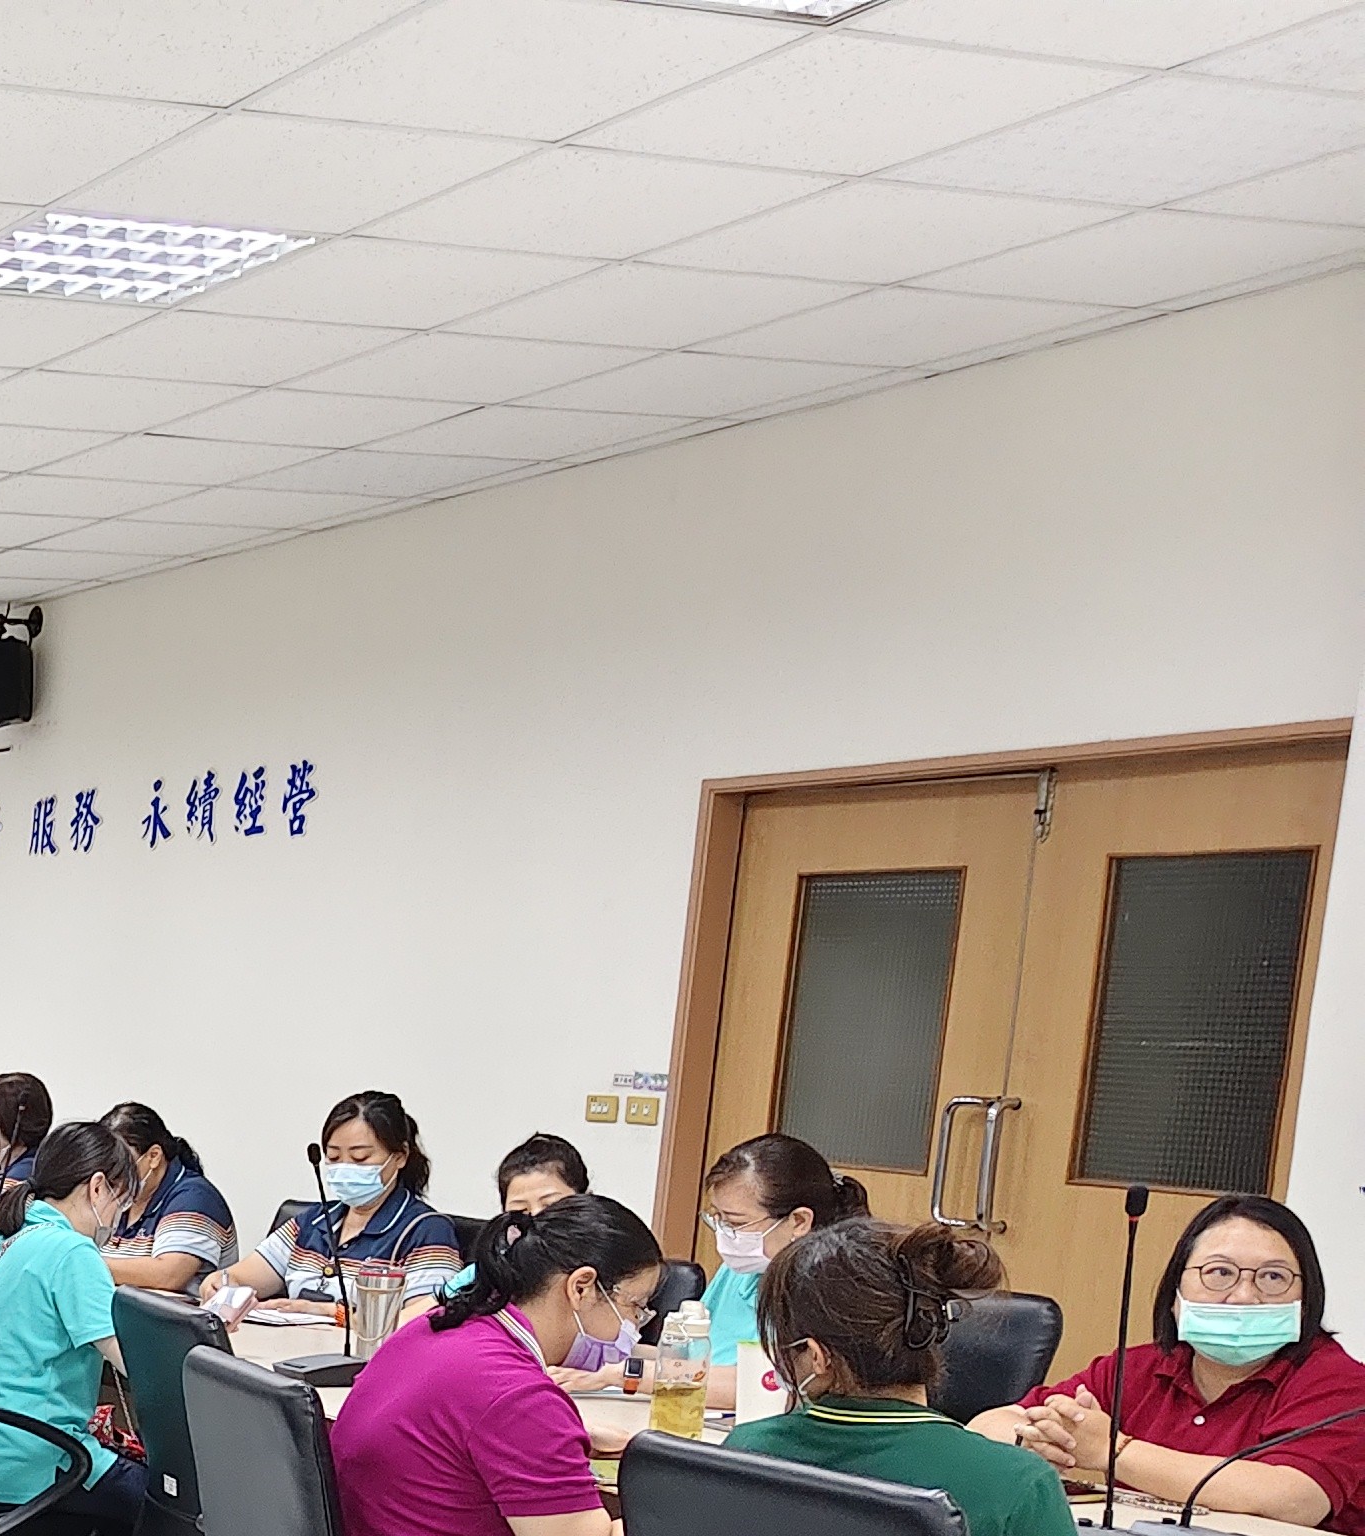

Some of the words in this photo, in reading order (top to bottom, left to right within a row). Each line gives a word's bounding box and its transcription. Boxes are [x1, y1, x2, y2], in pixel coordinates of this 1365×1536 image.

[29, 788, 101, 856] 服務
[141, 760, 316, 848] 永續經營
